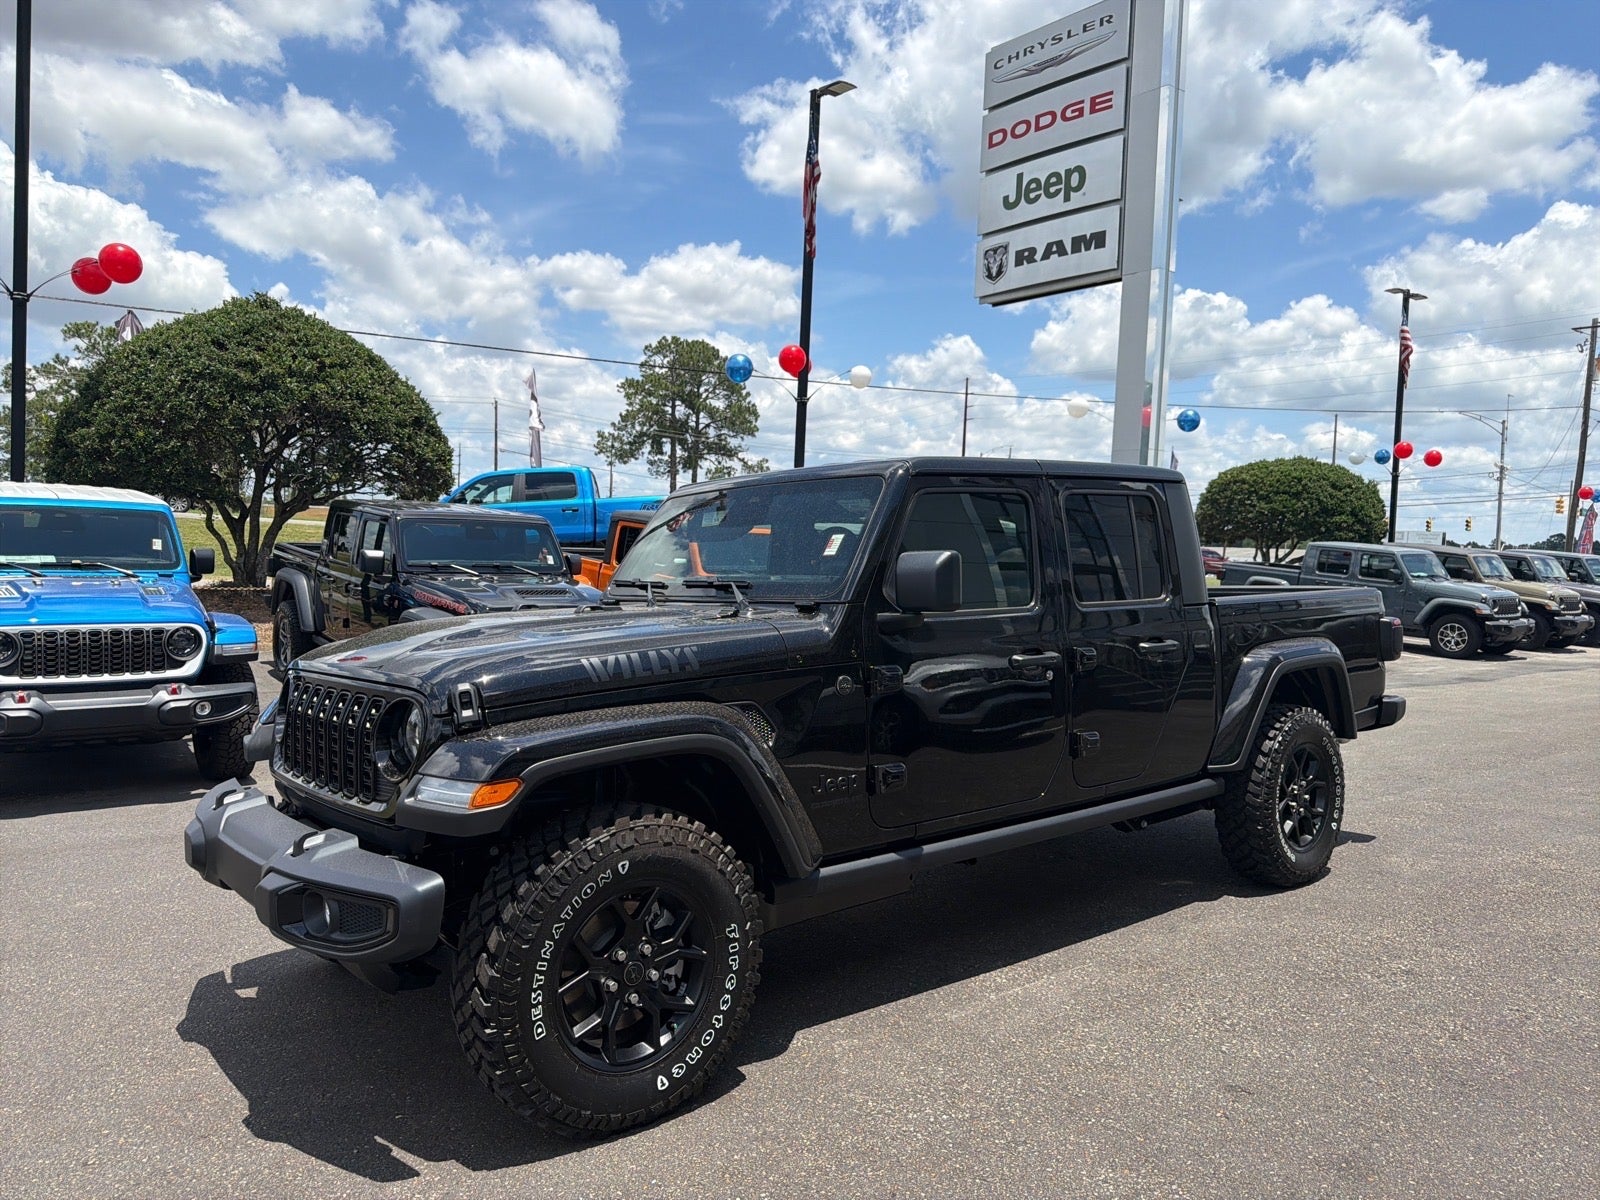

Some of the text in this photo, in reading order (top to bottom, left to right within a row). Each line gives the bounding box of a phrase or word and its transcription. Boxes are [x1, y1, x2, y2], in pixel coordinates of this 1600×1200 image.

[993, 14, 1114, 70] CHRYSLER
[988, 90, 1114, 149] DODGE
[1002, 164, 1087, 211] Jeep
[1014, 230, 1107, 268] RAM
[414, 590, 467, 614] MOJAVE
[580, 646, 700, 683] WILLYS
[811, 774, 858, 795] Jeep
[531, 868, 613, 1040] DESTINATION
